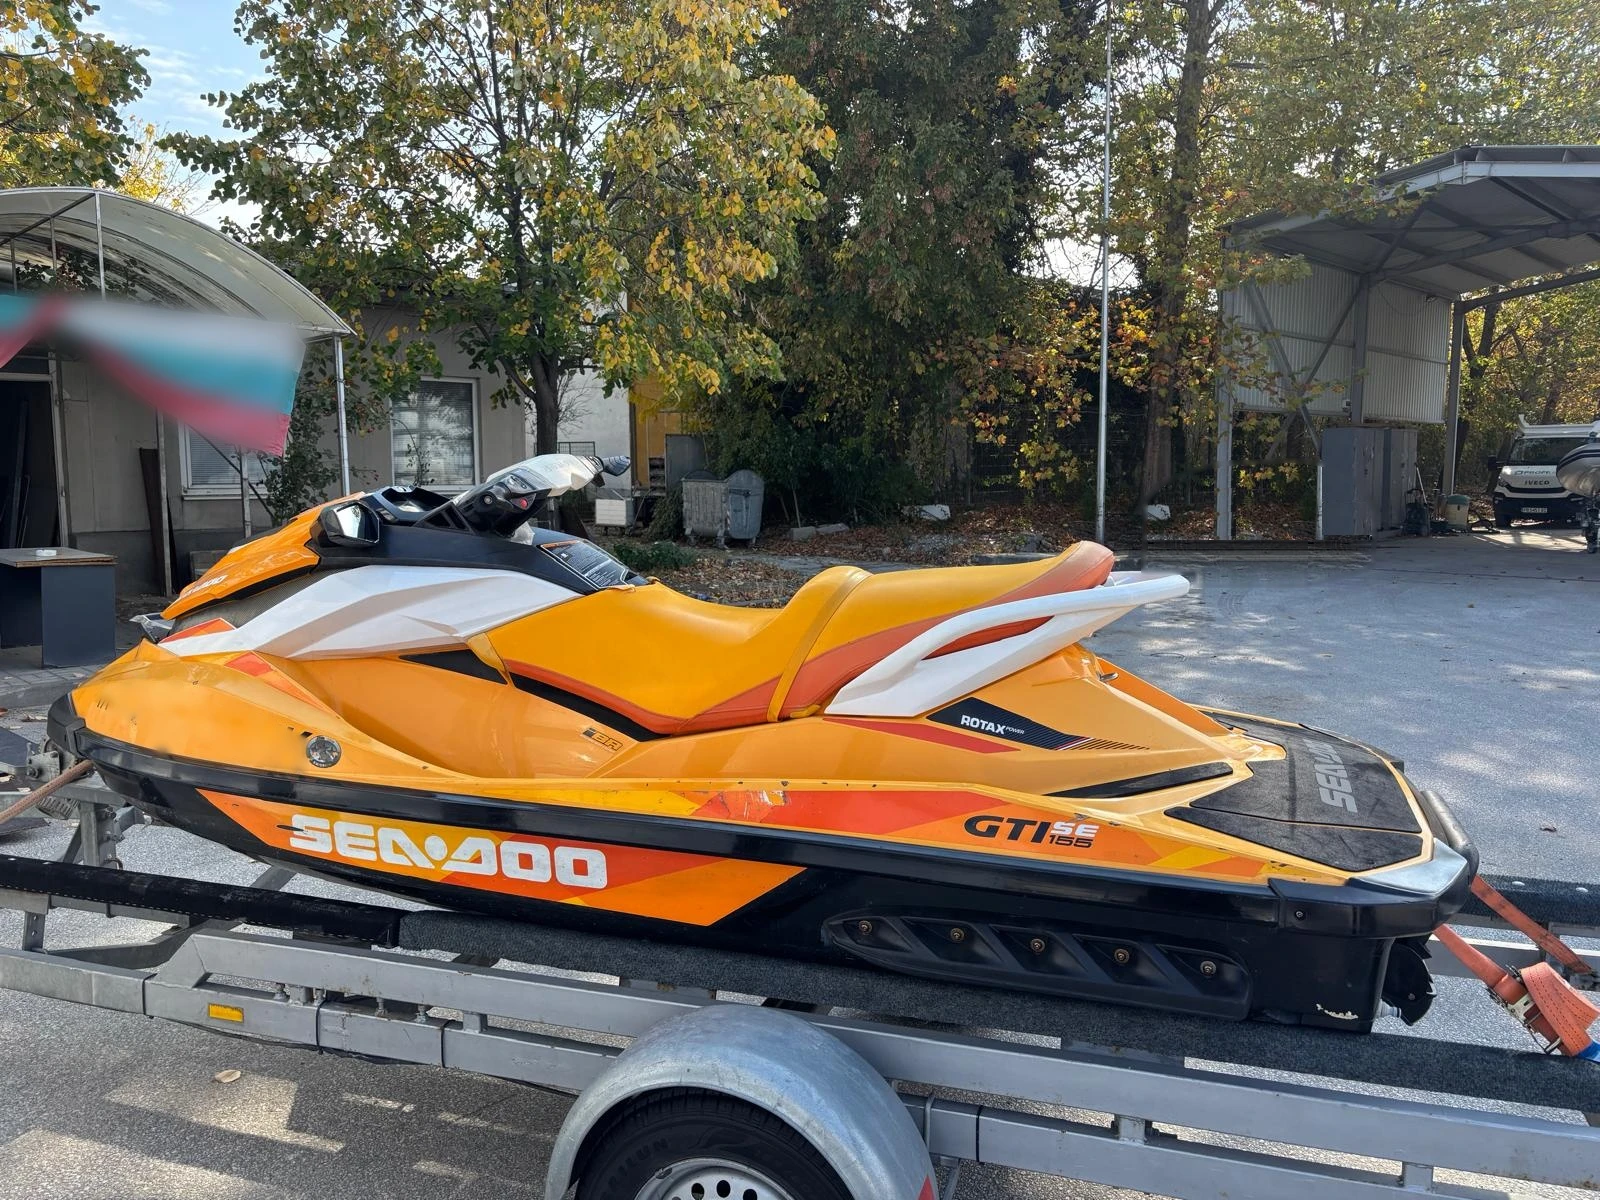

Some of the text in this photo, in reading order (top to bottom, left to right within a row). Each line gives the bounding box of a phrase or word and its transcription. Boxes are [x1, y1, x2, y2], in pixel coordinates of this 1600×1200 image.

[960, 714, 1025, 735] ROTAX POWER
[963, 815, 1100, 844] GTI SE
[1049, 834, 1094, 849] 155
